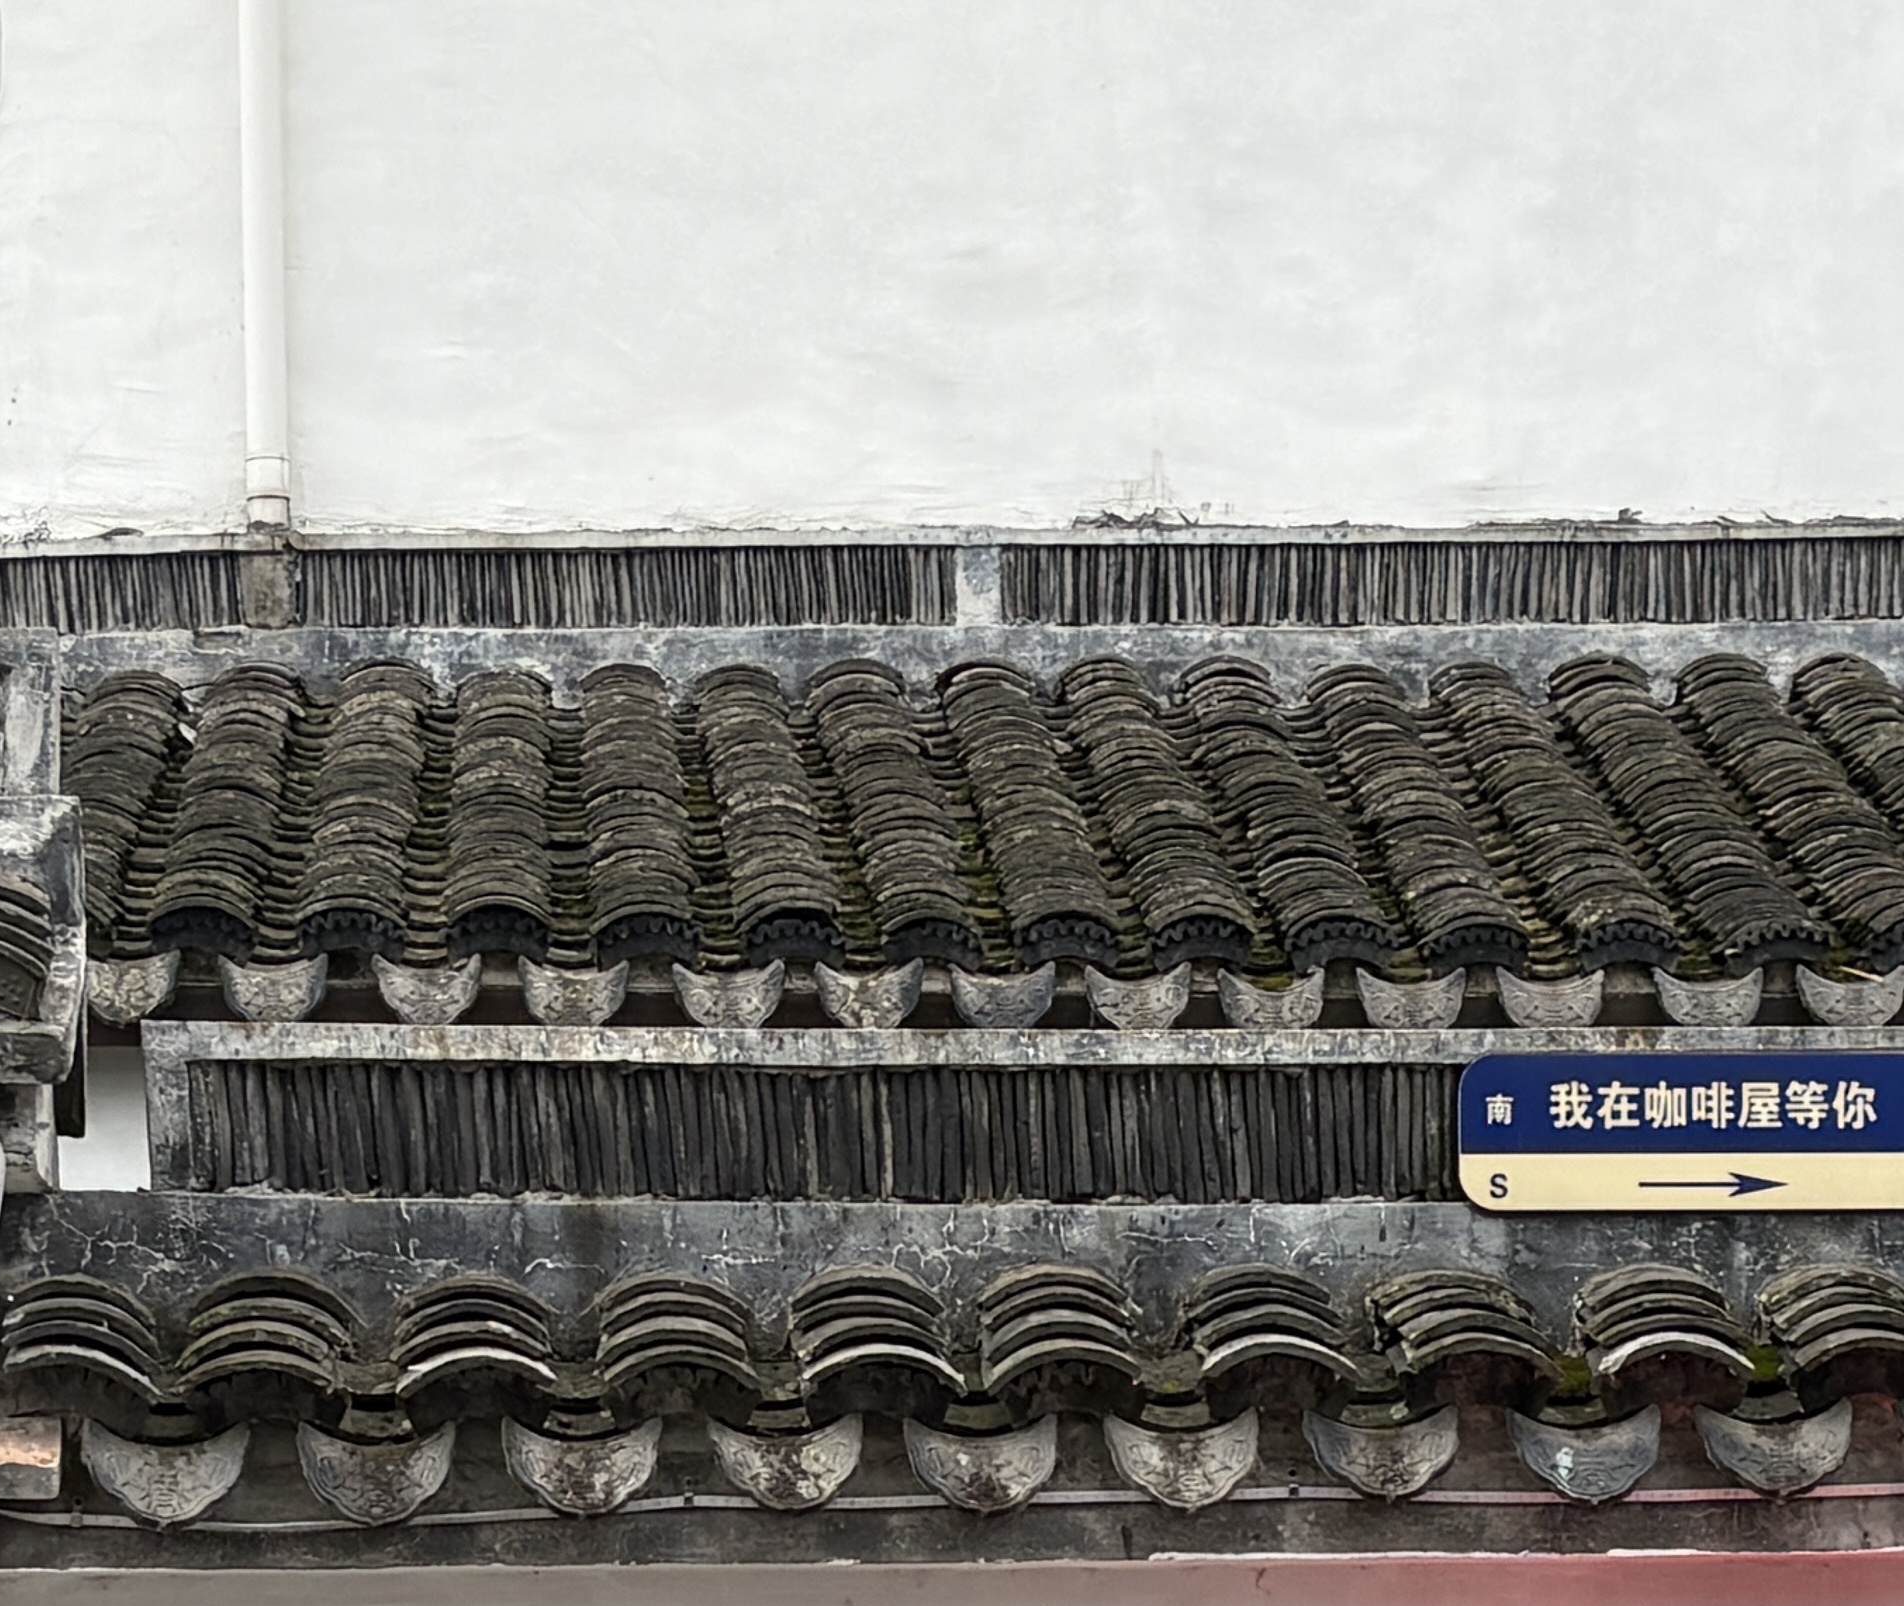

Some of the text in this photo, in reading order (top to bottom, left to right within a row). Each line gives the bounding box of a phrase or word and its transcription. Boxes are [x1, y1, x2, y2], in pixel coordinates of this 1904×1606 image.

[1486, 1093, 1514, 1126] 南
[1549, 1081, 1877, 1130] 我在咖啡屋等你
[1489, 1172, 1509, 1199] S
